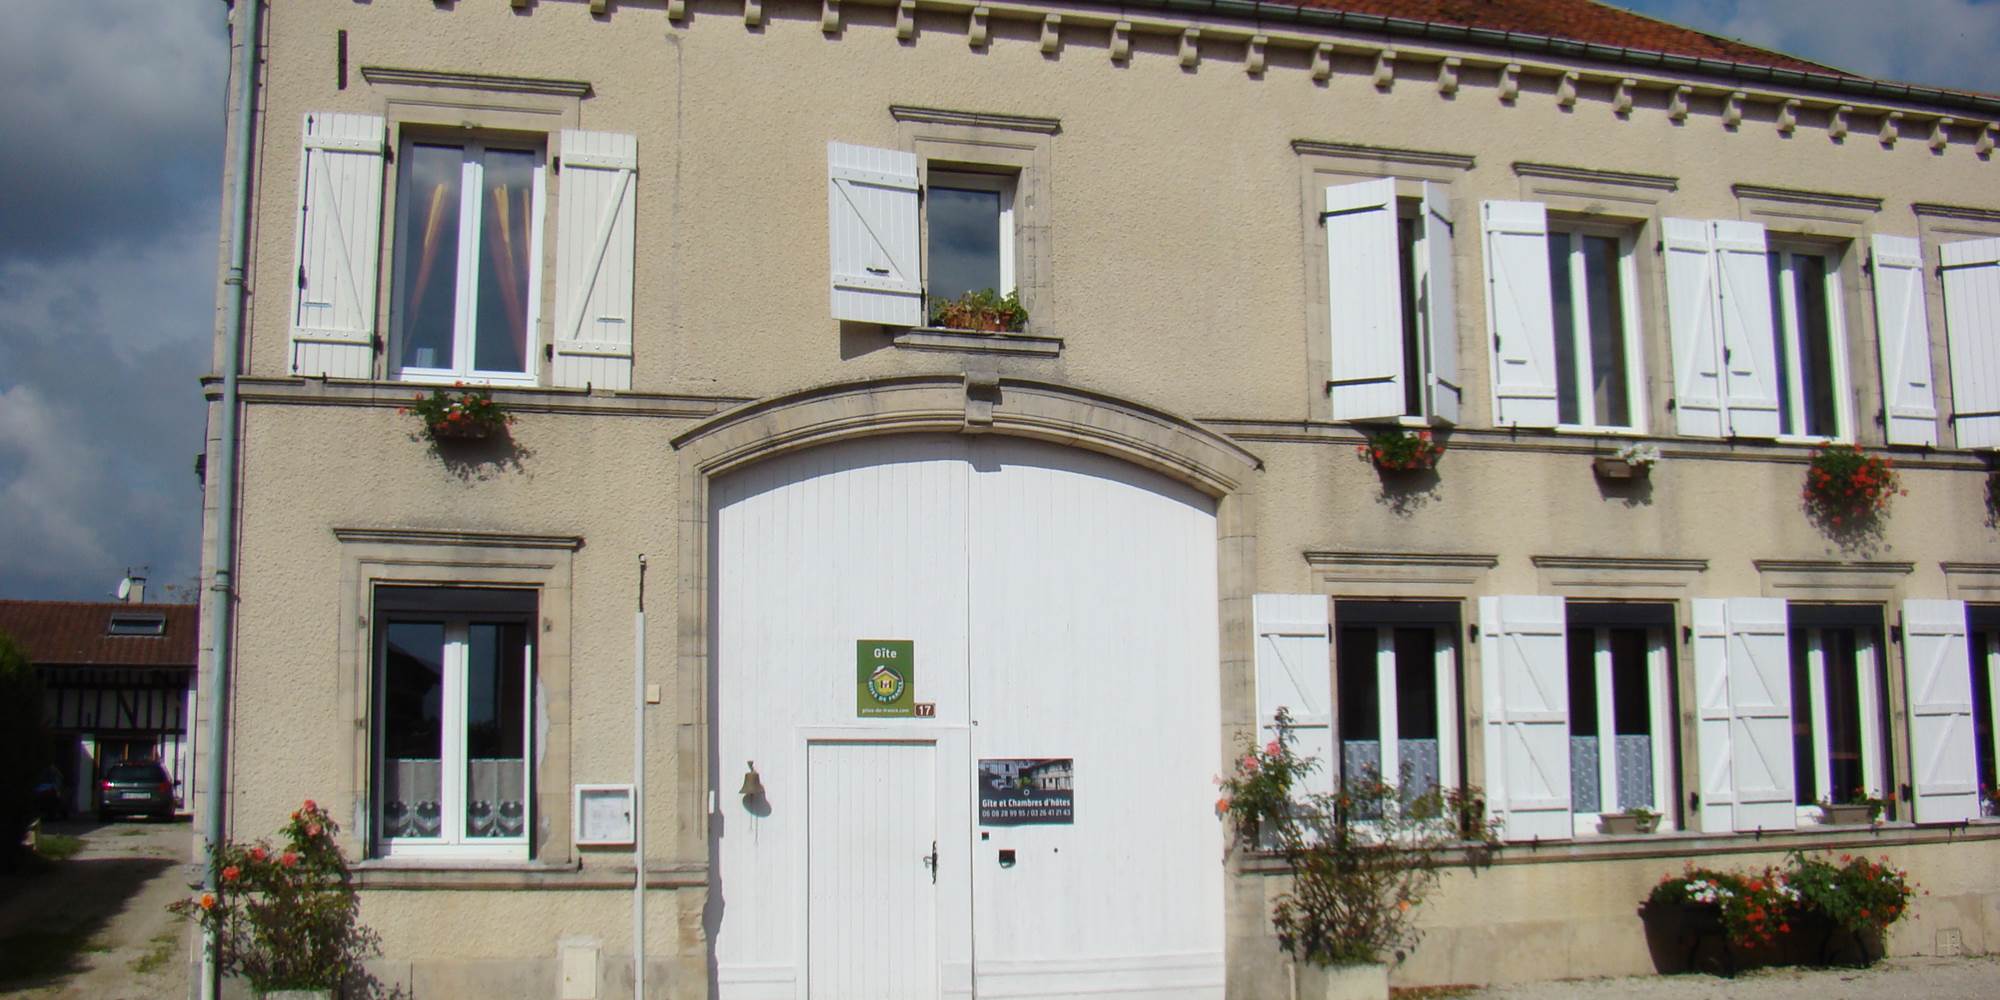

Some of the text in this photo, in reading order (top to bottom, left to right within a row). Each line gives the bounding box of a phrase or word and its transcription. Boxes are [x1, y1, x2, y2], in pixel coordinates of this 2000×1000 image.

[874, 648, 897, 658] Gîte
[919, 705, 931, 716] 17
[999, 800, 1007, 808] et
[1008, 798, 1042, 808] Chambres
